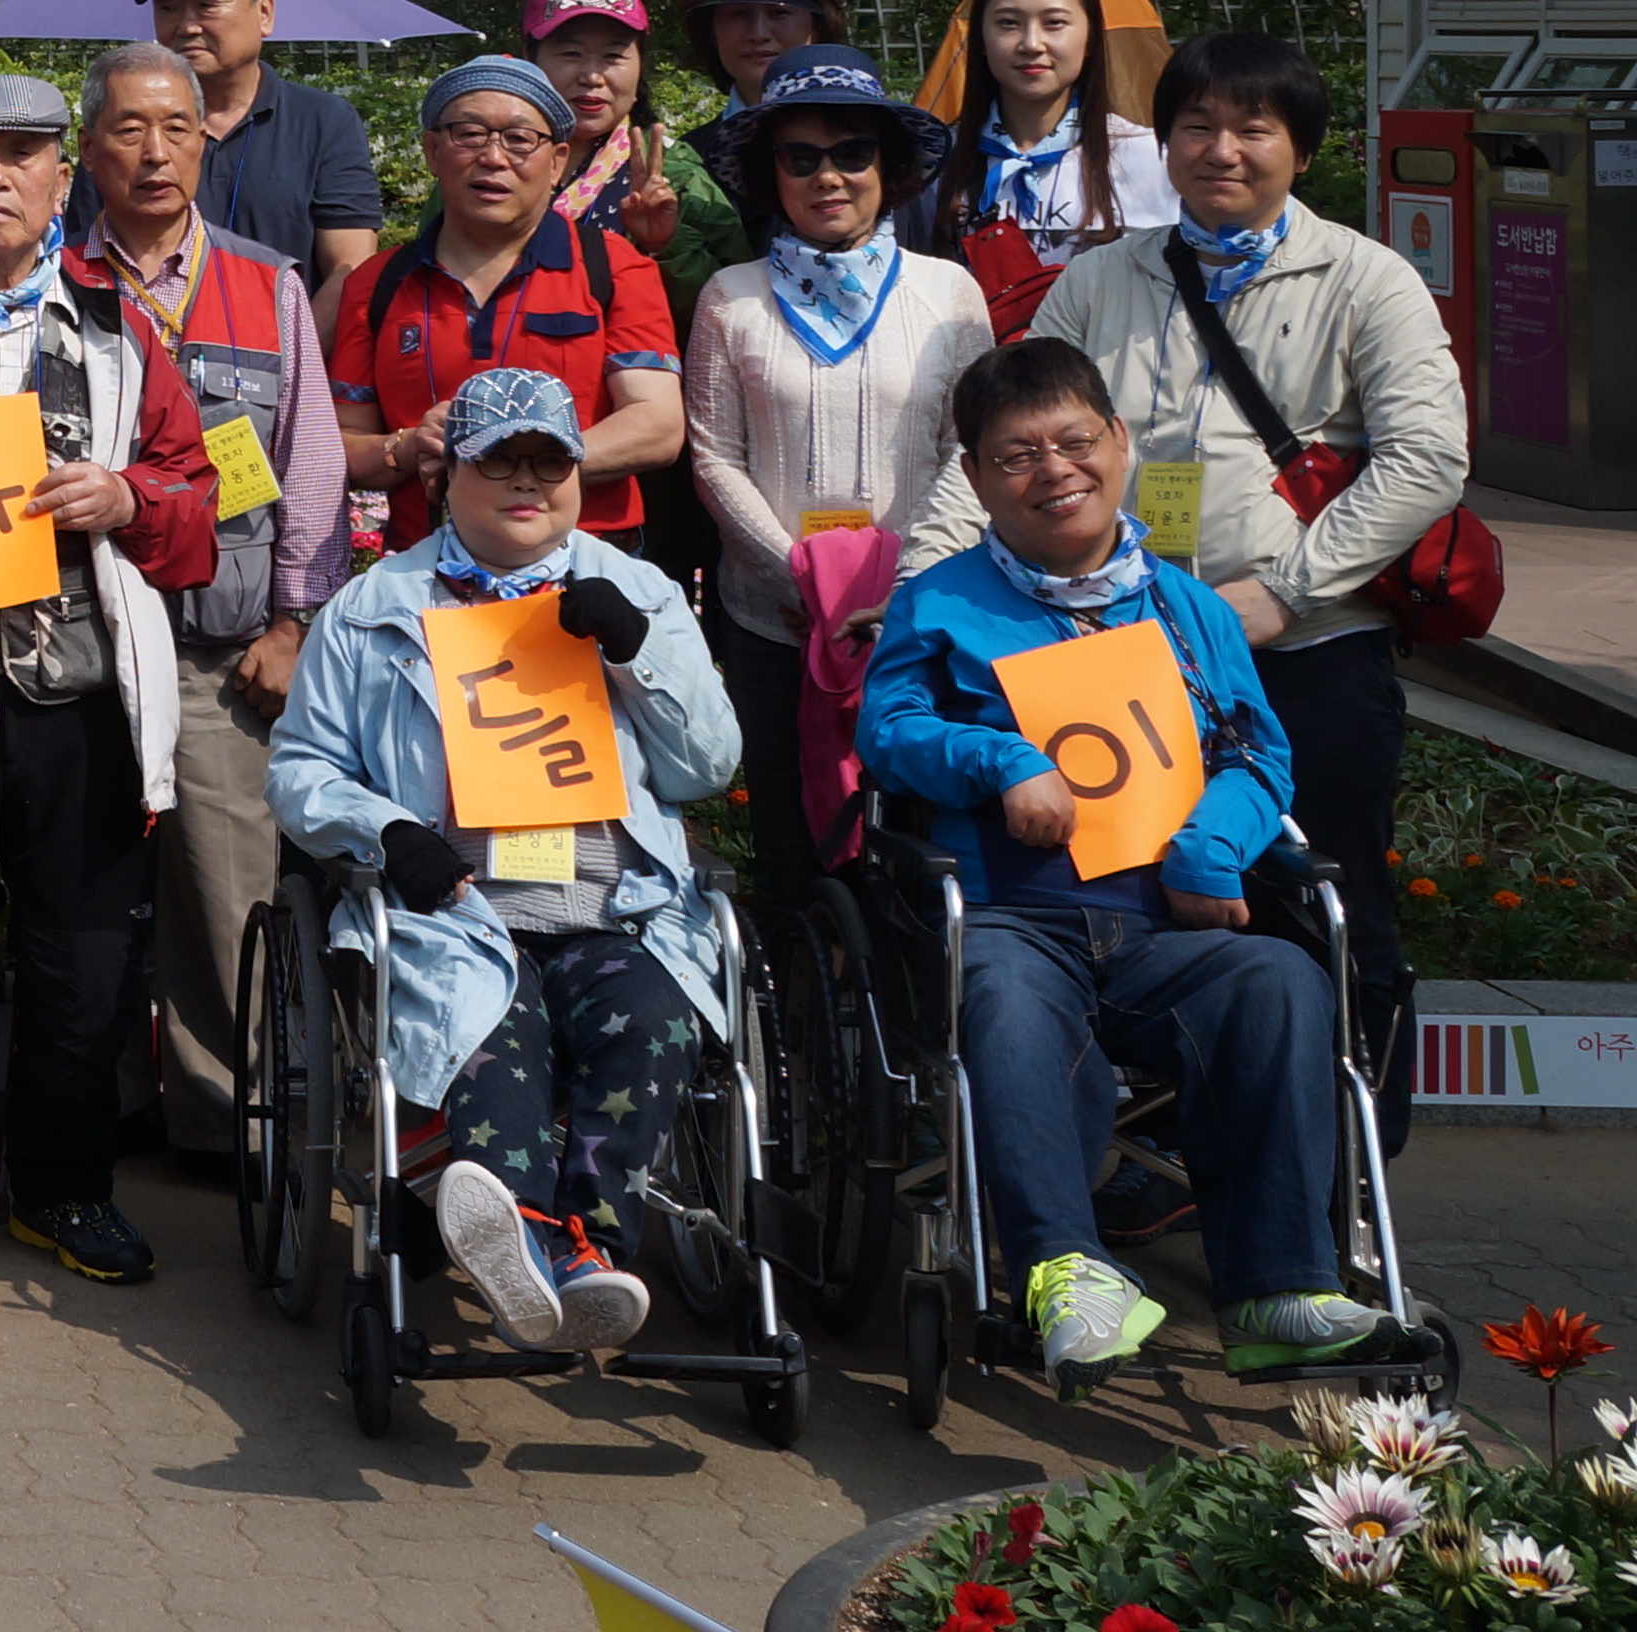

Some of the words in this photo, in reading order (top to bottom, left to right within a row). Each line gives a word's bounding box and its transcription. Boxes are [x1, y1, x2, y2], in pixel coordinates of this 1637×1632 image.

[1496, 223, 1559, 256] 도서반납함
[456, 658, 595, 789] 들
[1043, 698, 1174, 800] 이
